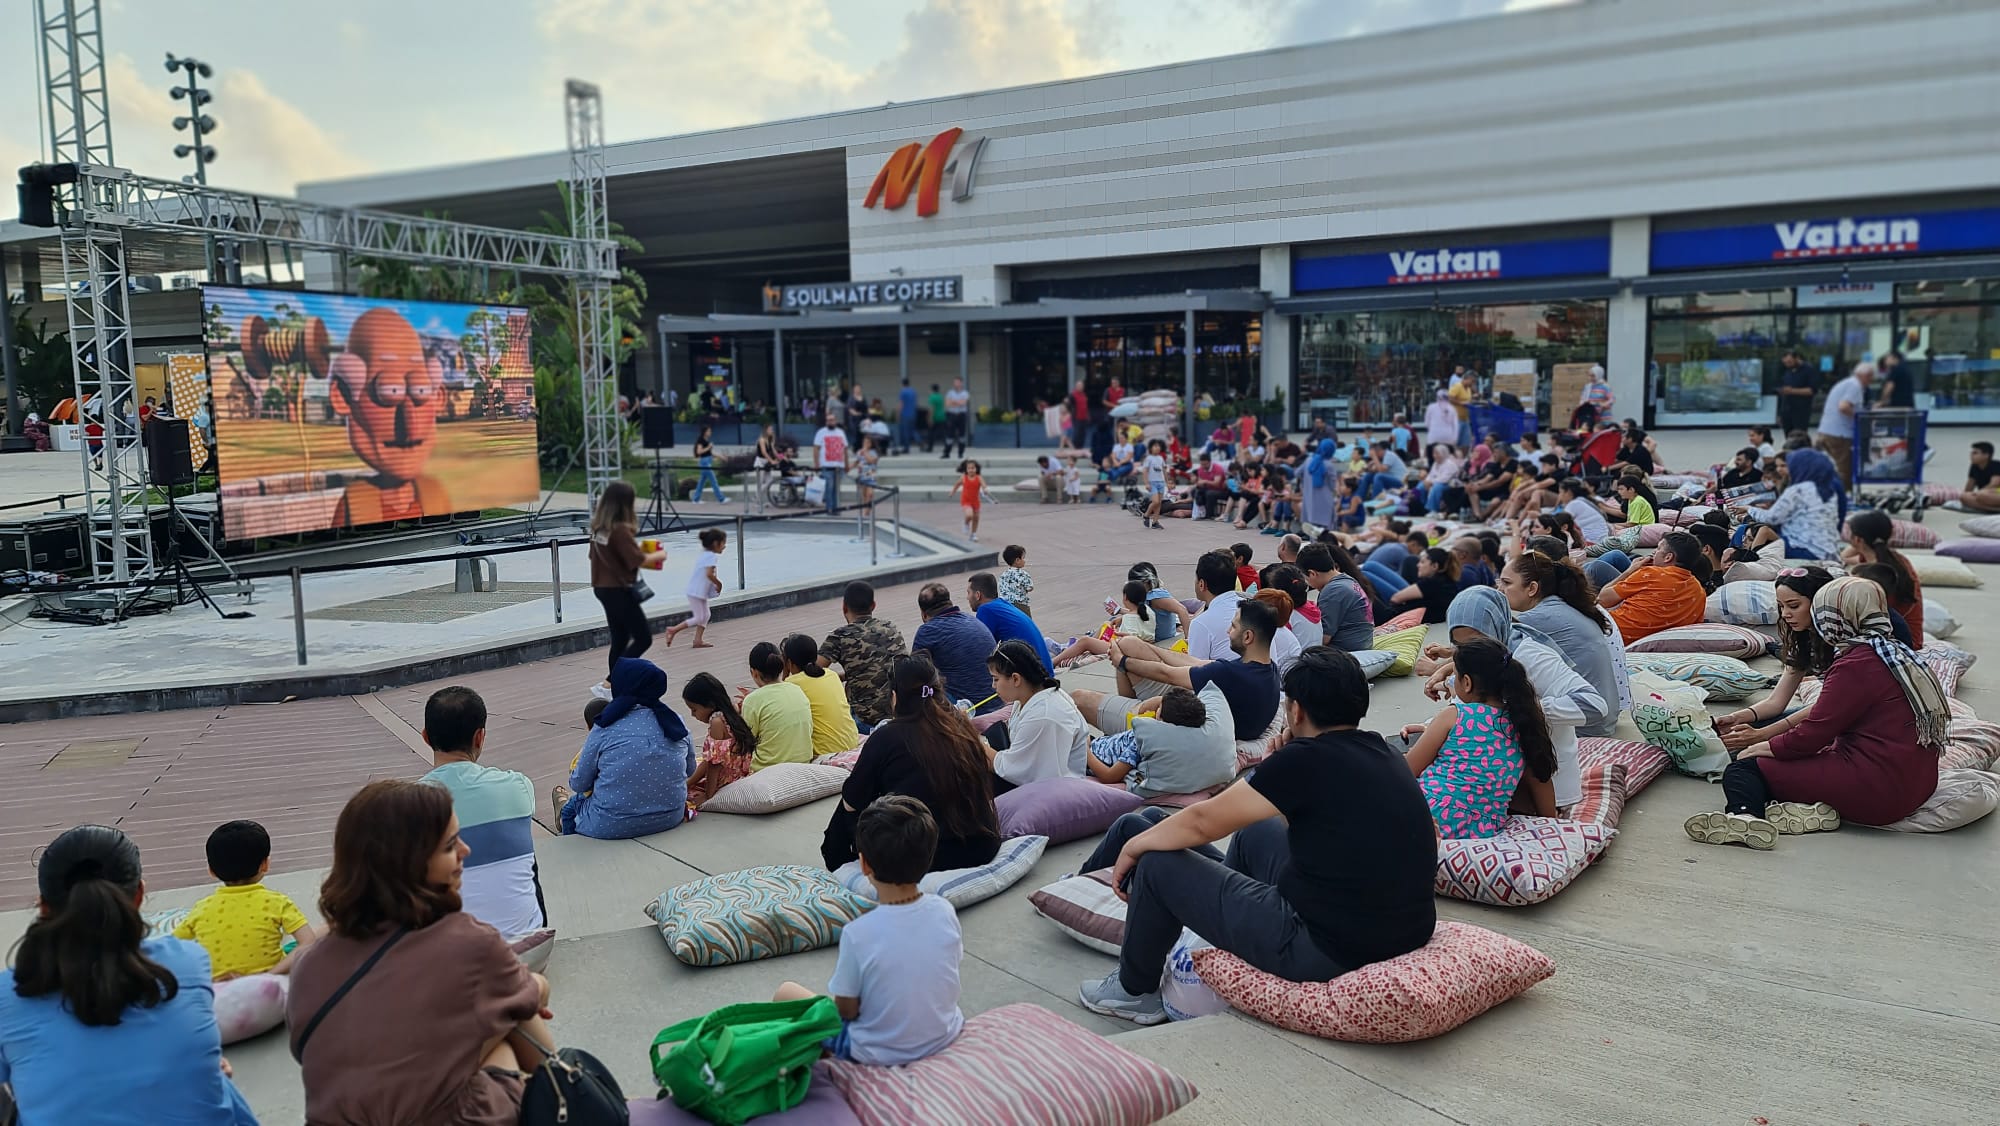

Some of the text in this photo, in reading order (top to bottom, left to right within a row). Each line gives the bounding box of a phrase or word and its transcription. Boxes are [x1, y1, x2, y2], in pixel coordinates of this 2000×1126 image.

[863, 127, 990, 217] M1
[1775, 218, 1919, 250] Vatan
[1389, 249, 1500, 276] Vatan
[787, 280, 955, 307] SOULMATE COFFEE
